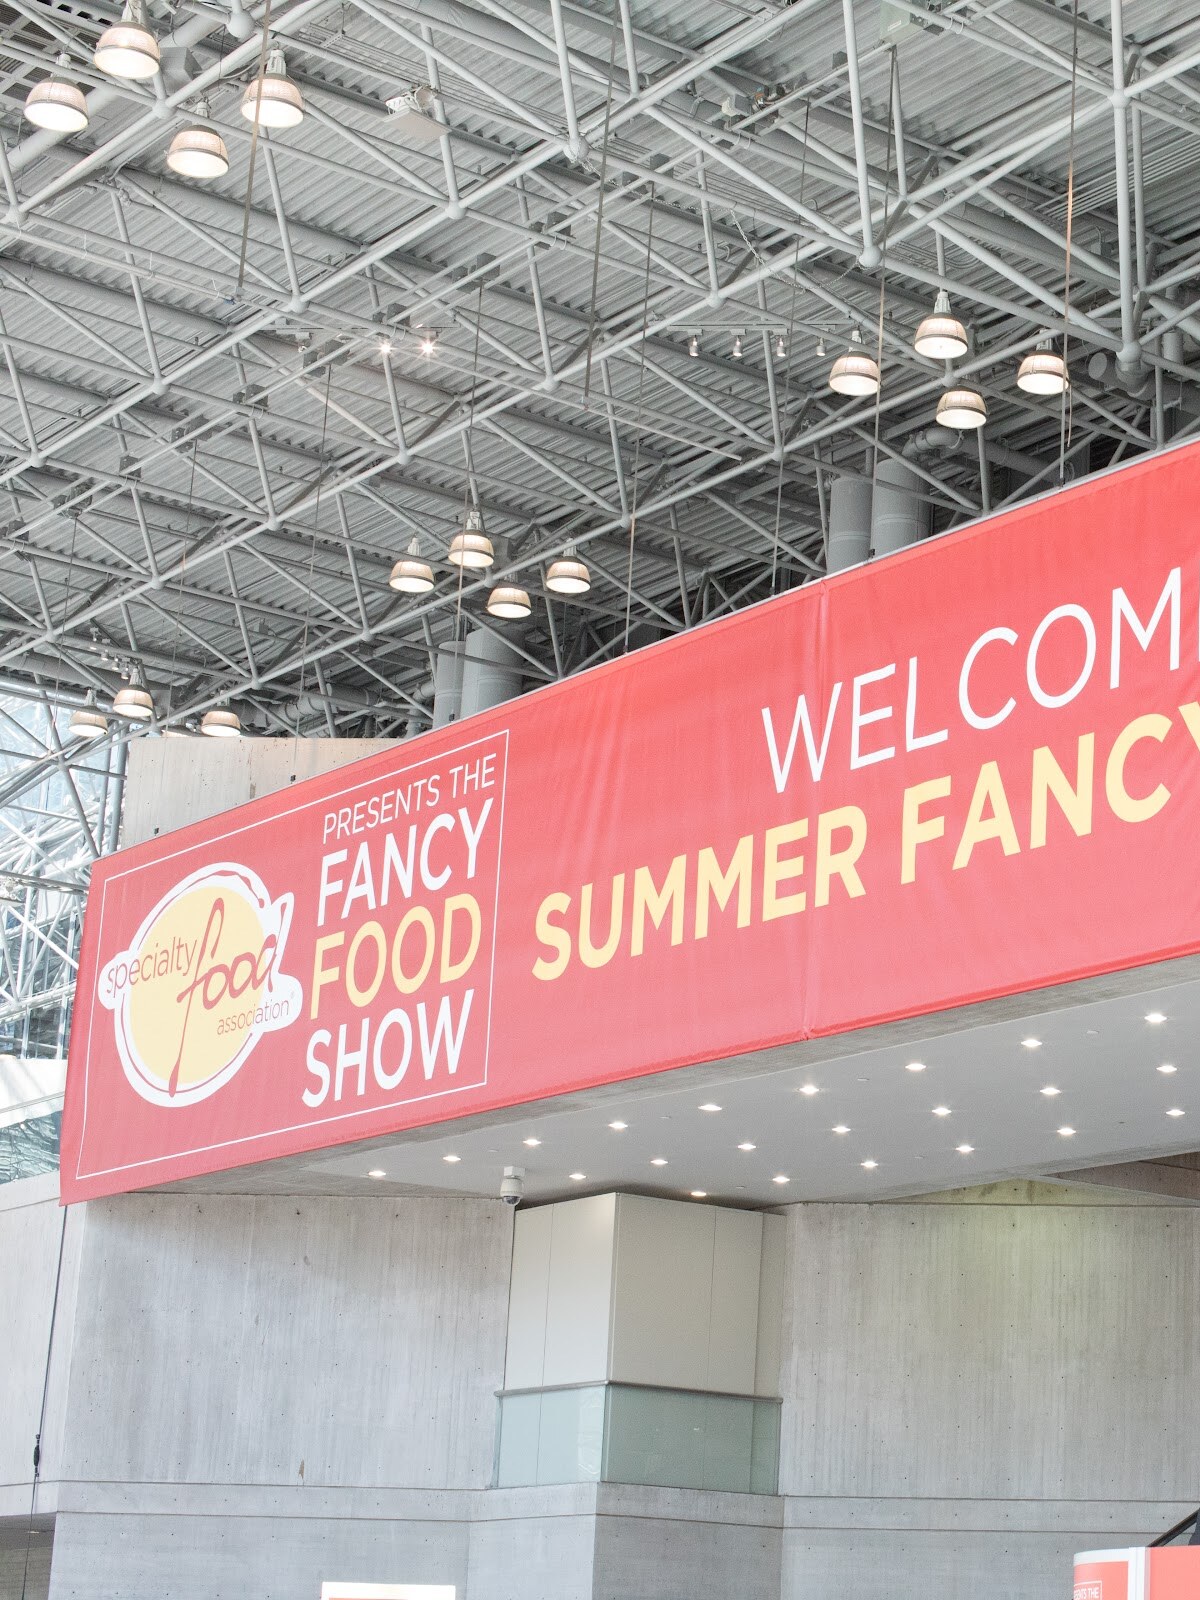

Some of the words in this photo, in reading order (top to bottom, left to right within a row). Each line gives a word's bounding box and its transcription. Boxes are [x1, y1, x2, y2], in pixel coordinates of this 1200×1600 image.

[317, 798, 494, 926] FANCY
[323, 774, 441, 845] PRESENTS
[449, 753, 497, 798] THE
[311, 893, 482, 1020] FOOD
[532, 806, 868, 980] SUMMER
[106, 936, 198, 999] specialty
[169, 897, 288, 1098] food
[216, 999, 290, 1036] association
[302, 989, 475, 1108] SHOW
